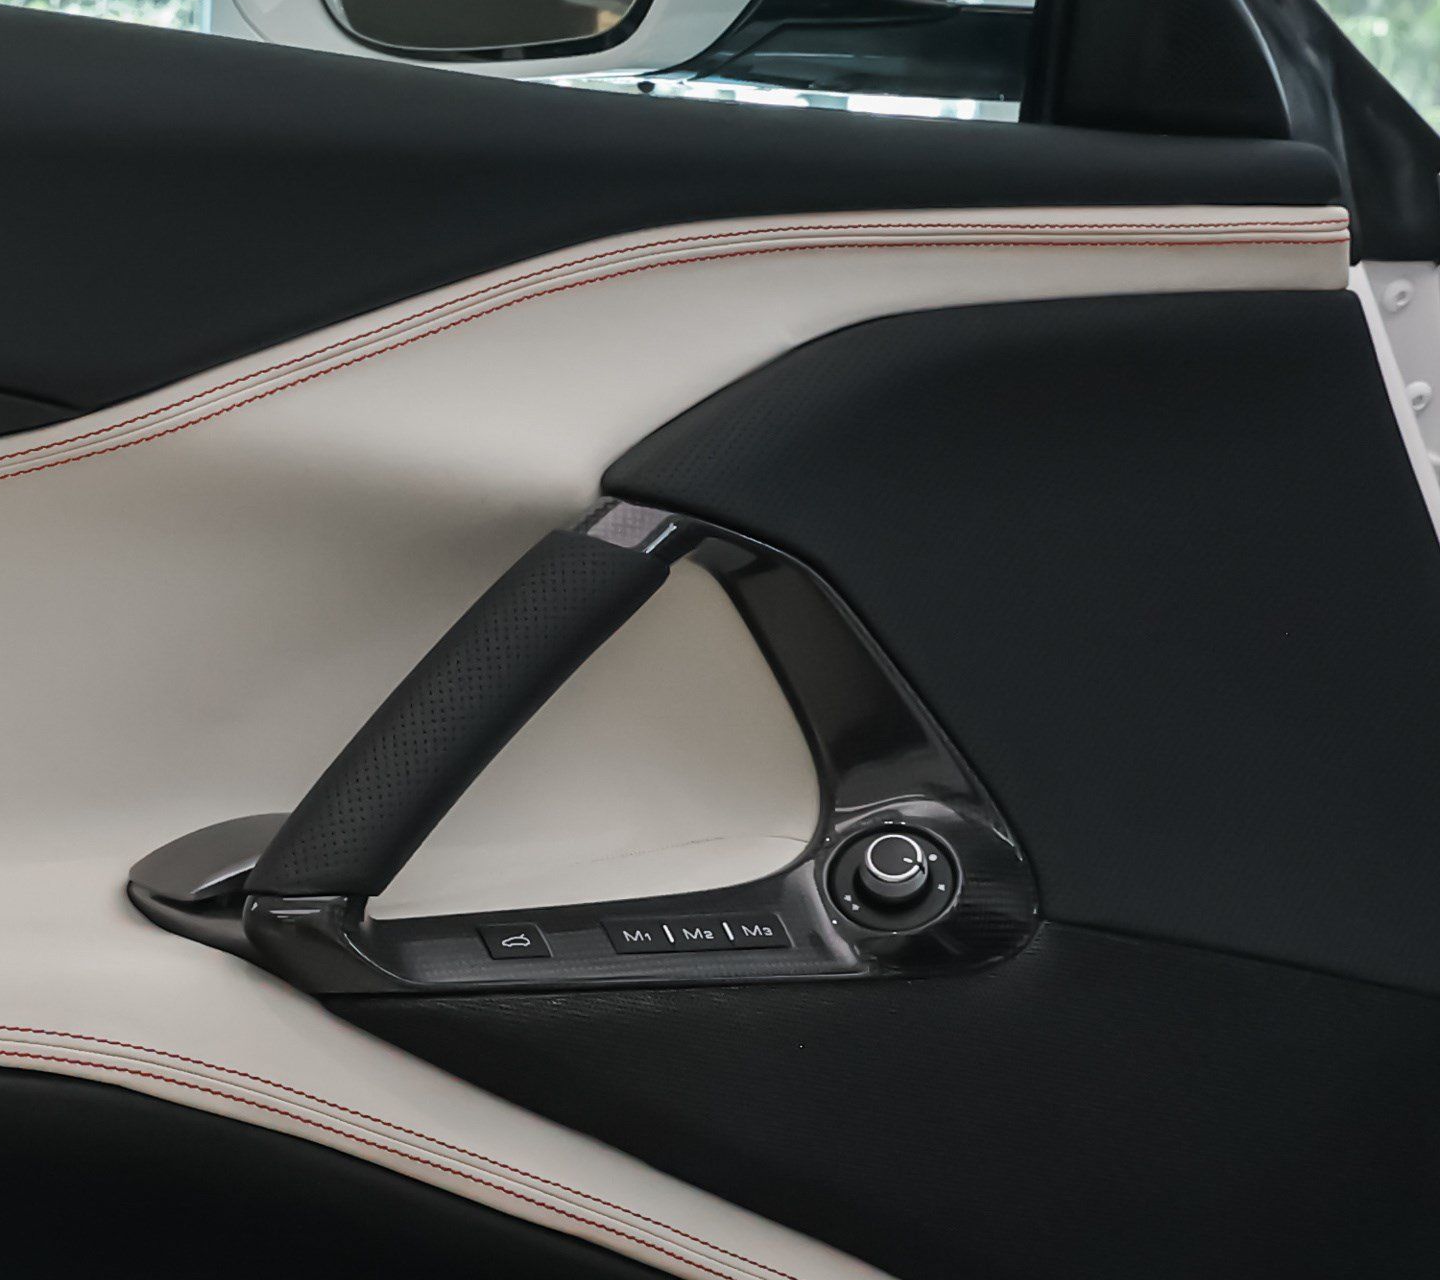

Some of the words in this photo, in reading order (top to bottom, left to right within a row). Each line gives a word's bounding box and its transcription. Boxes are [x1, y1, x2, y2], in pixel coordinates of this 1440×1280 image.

[622, 929, 652, 942] M1
[682, 927, 714, 940] M2
[741, 924, 773, 937] M3
